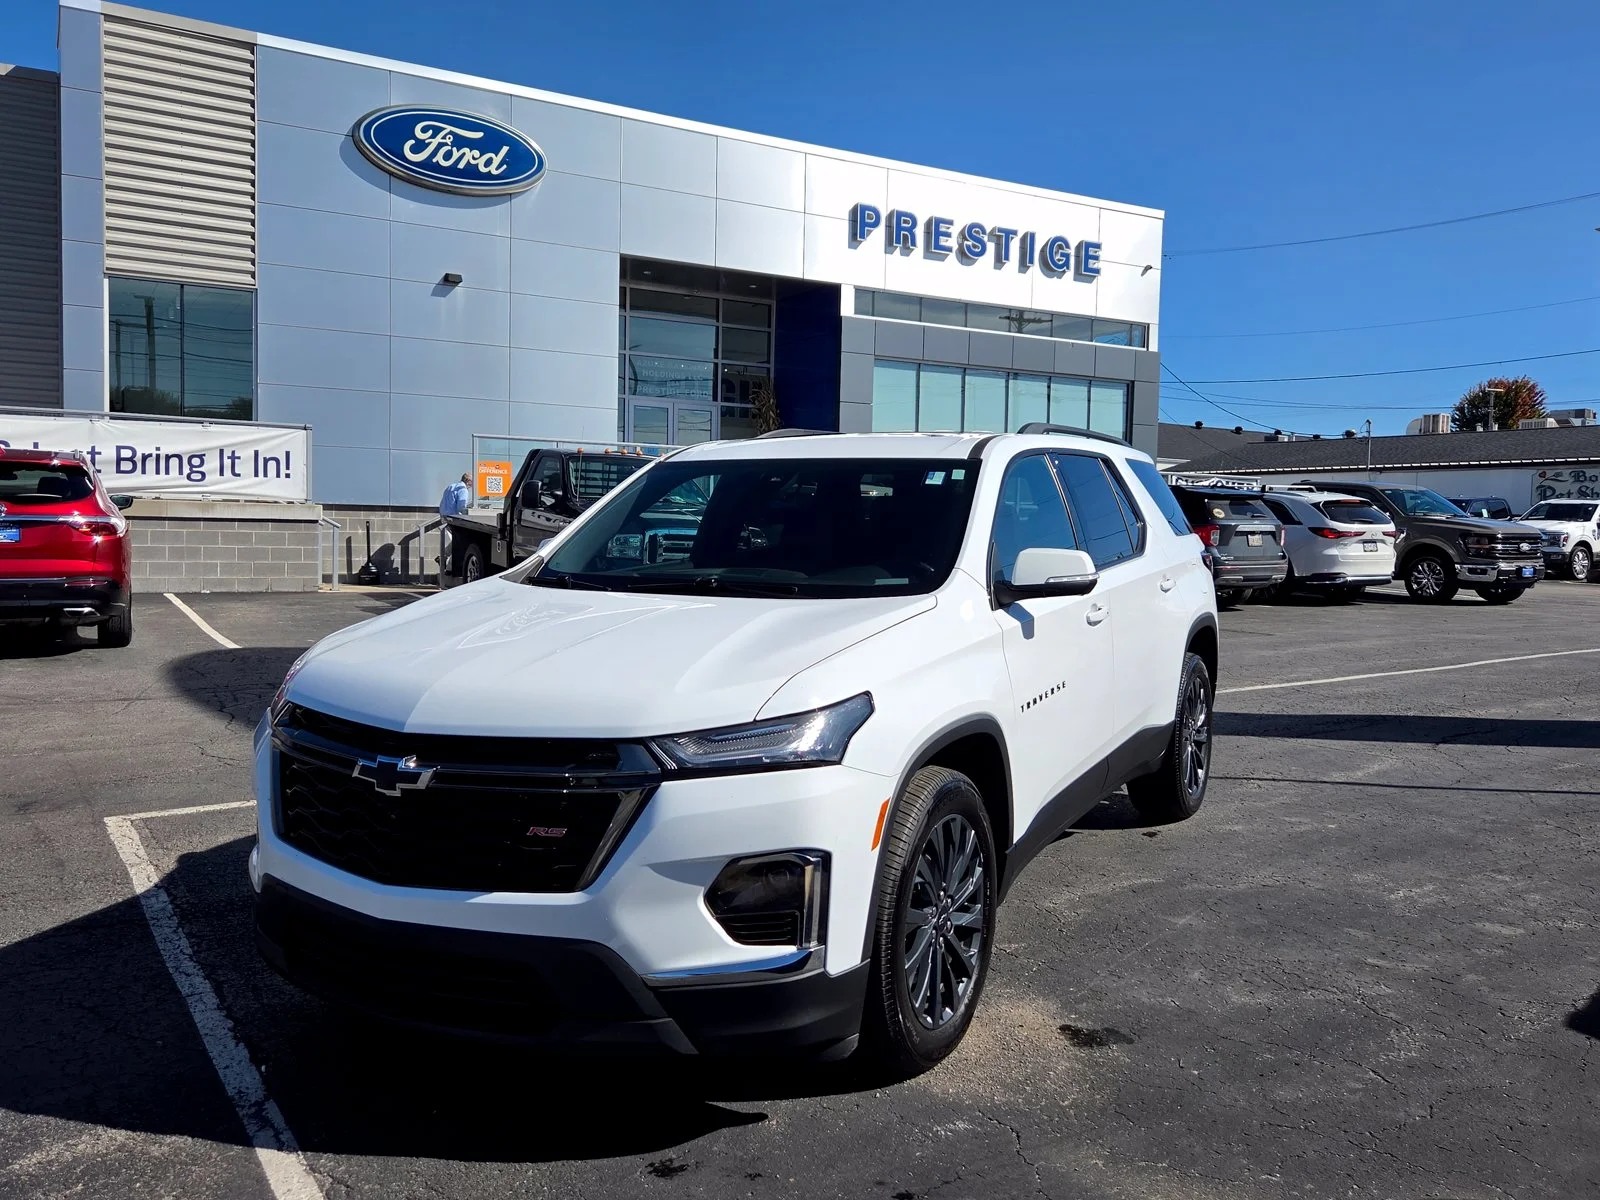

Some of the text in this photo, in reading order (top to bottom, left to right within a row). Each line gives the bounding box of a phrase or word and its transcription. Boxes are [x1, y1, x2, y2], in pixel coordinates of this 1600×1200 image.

[403, 120, 510, 175] Ford
[850, 203, 1103, 280] PRESTIGE
[115, 445, 206, 482] Bring
[218, 448, 242, 477] It
[253, 449, 291, 479] In!
[1536, 484, 1573, 500] Pet
[1020, 680, 1066, 713] TRAVERSE
[526, 826, 568, 837] RS
